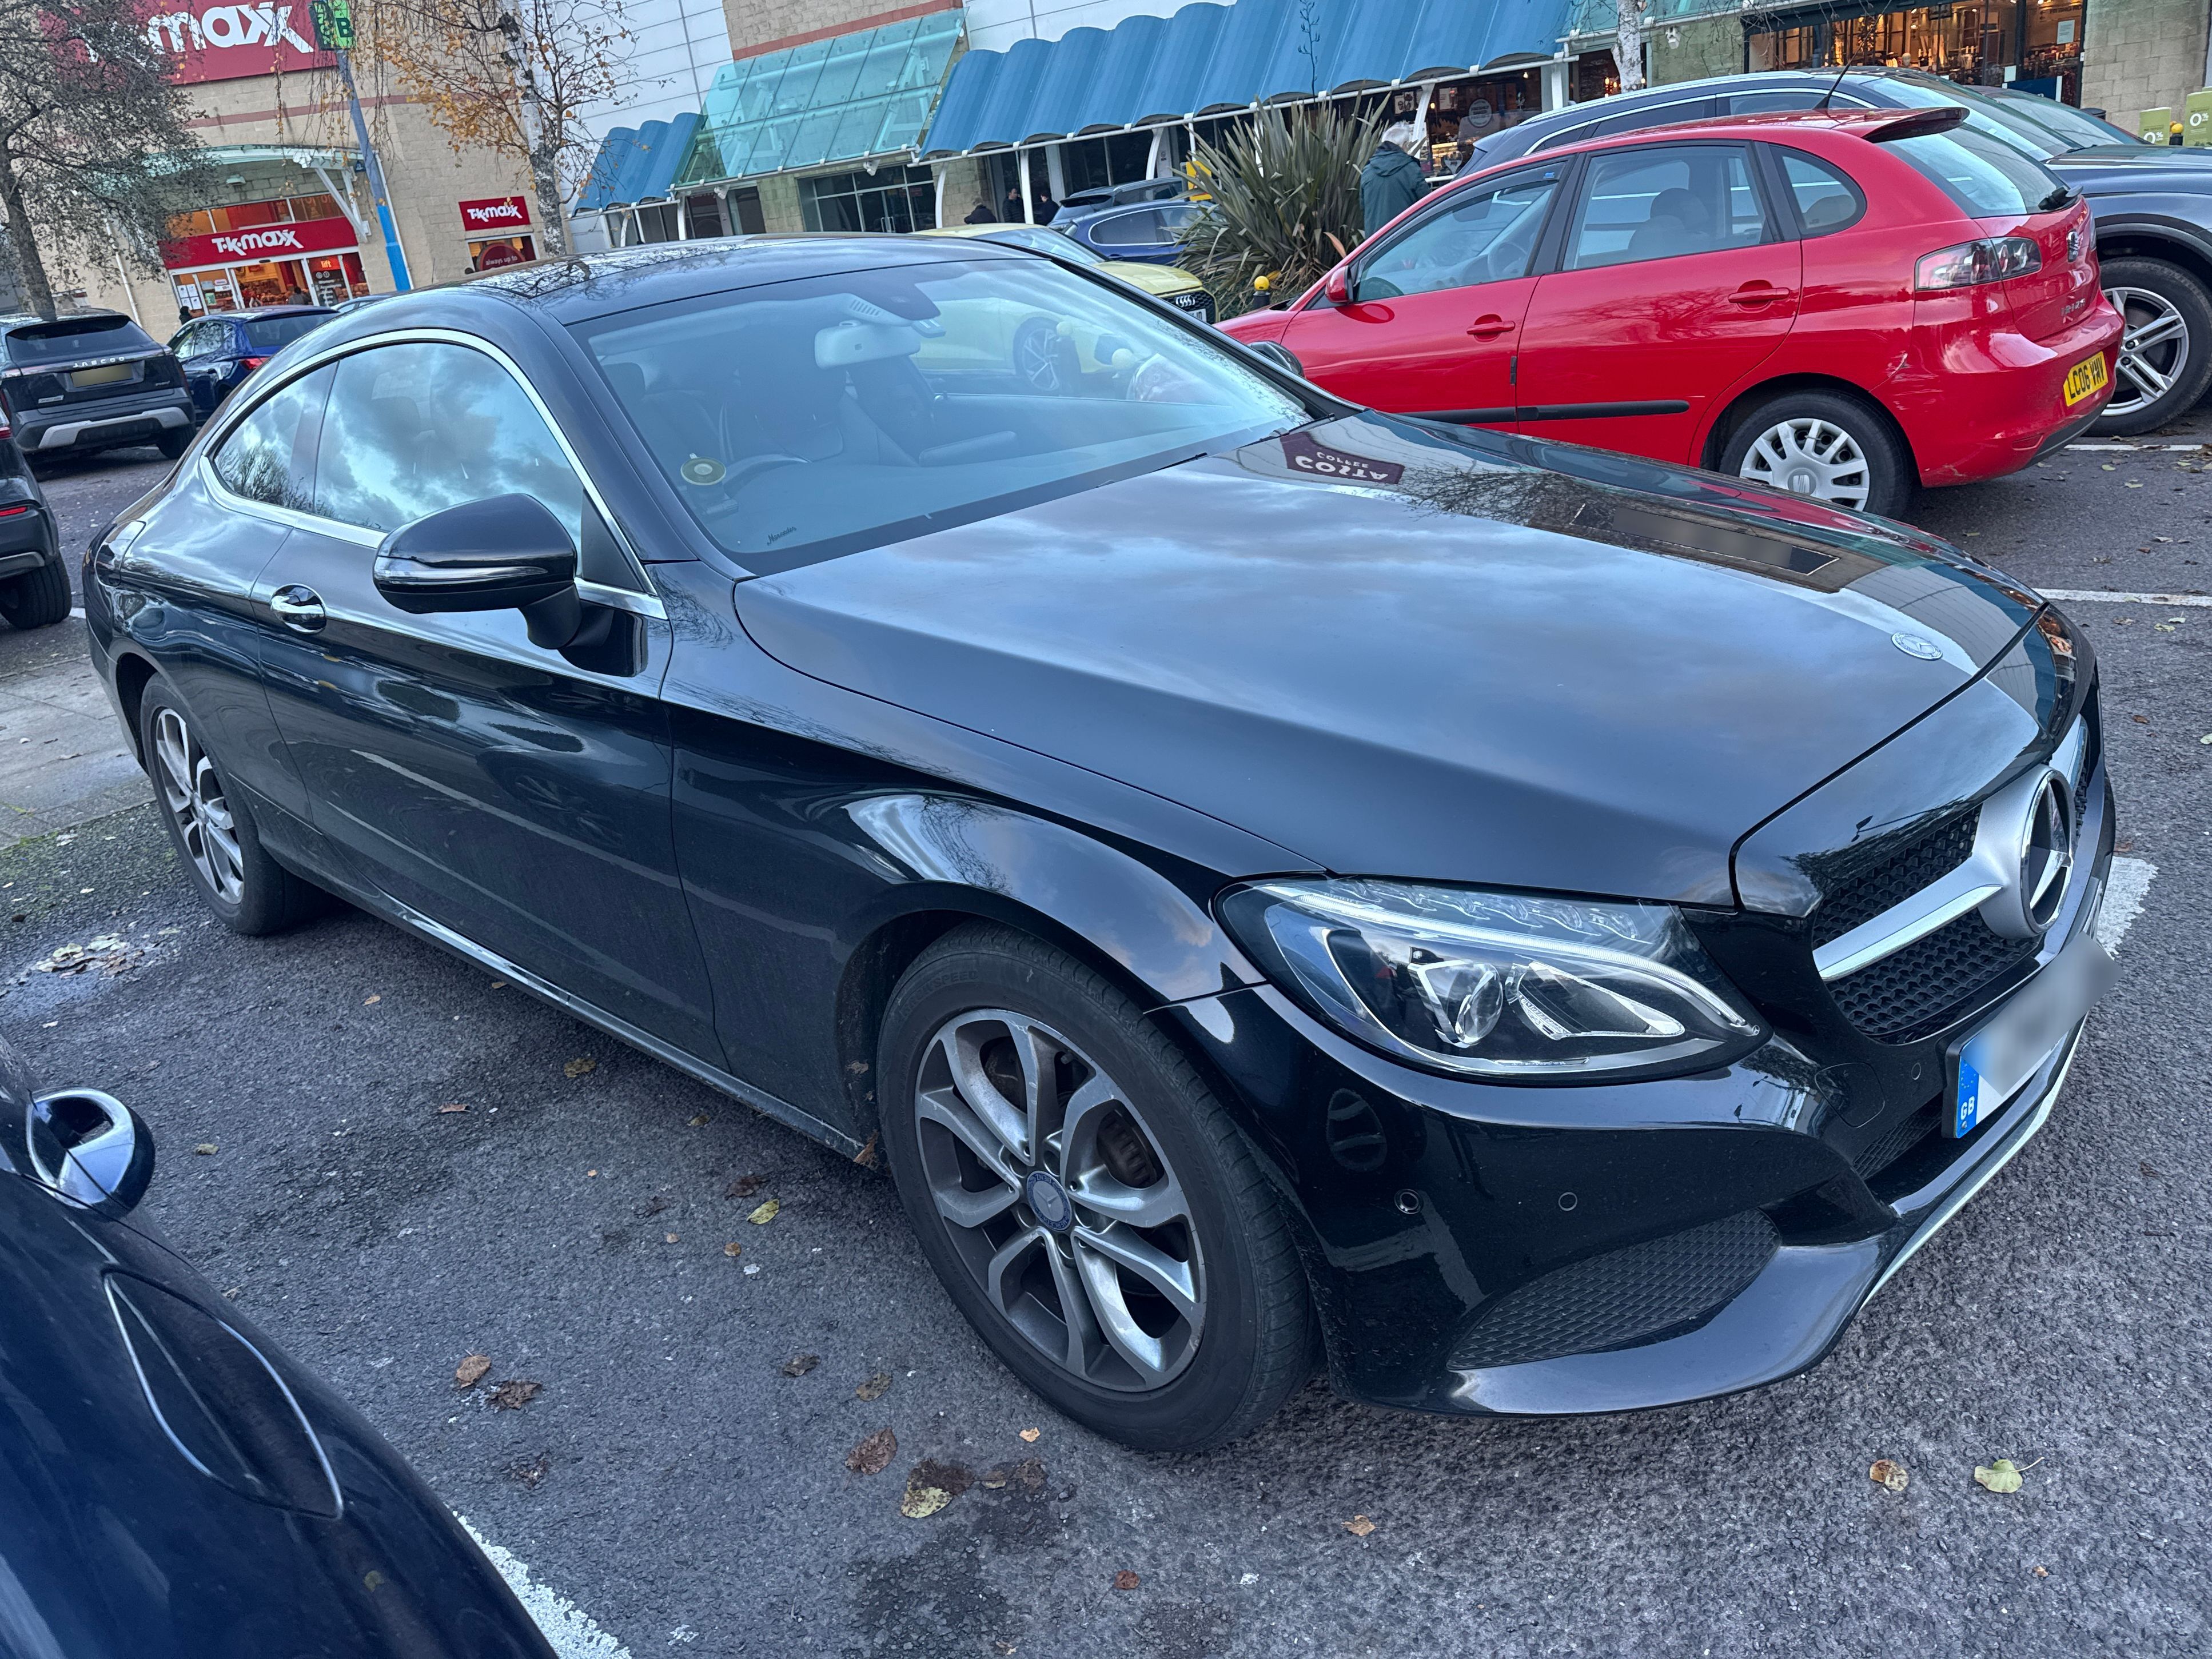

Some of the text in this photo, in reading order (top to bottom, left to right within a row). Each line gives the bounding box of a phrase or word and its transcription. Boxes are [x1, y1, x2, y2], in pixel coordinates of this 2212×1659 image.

[321, 260, 332, 268] lift
[2067, 364, 2091, 399] LC06
[1960, 1096, 1975, 1120] GB
